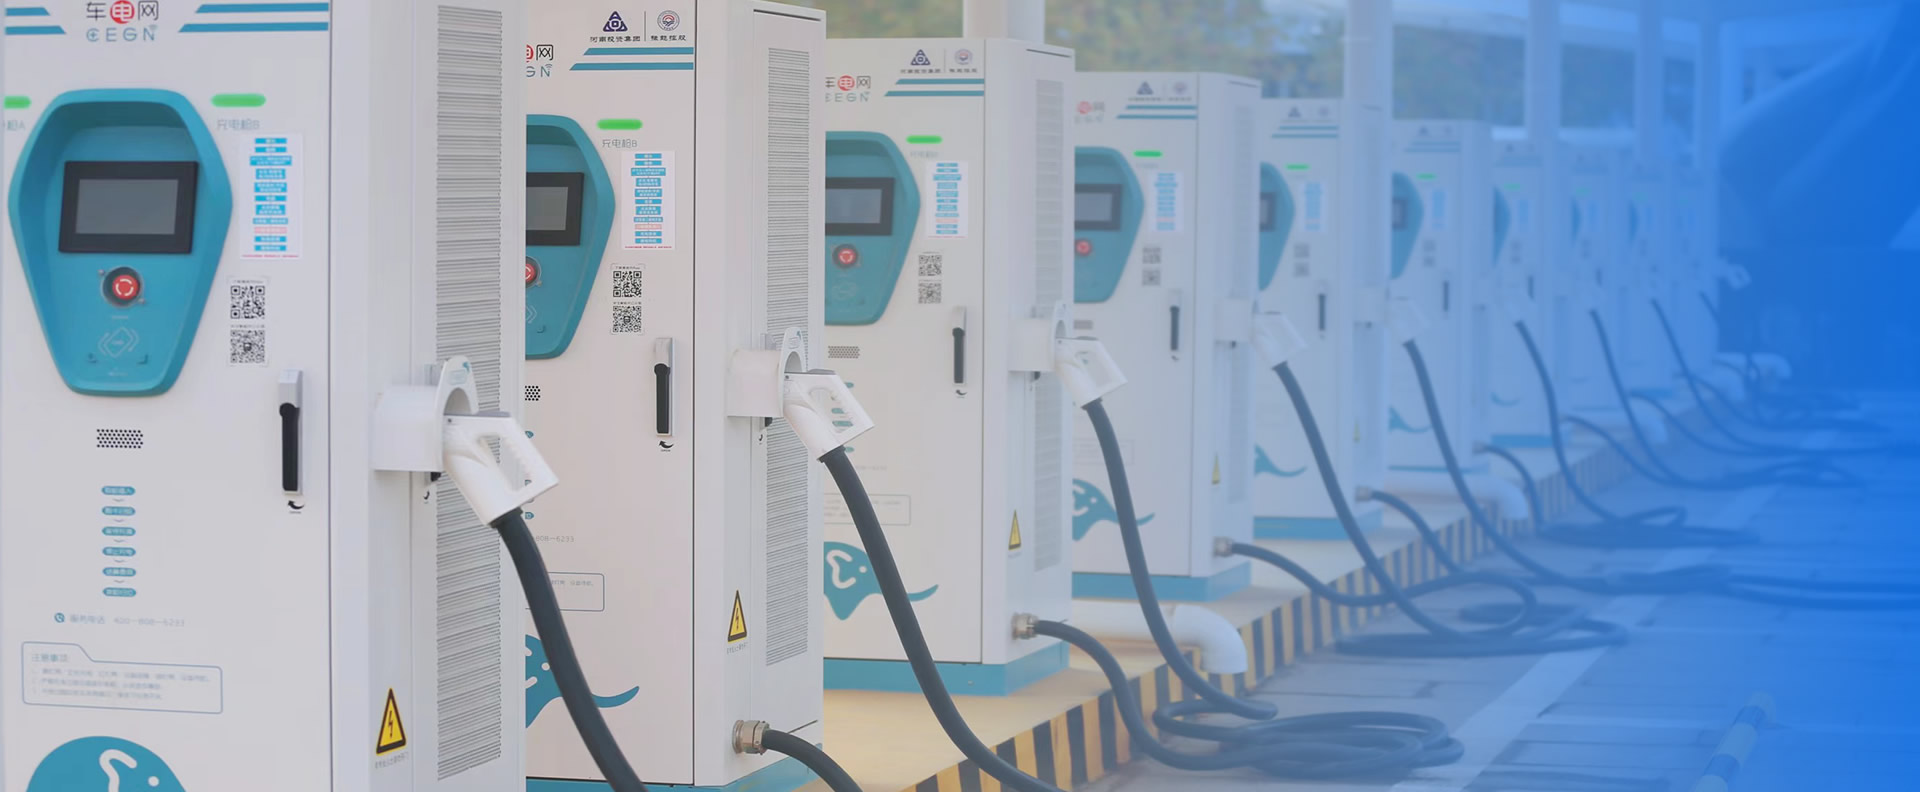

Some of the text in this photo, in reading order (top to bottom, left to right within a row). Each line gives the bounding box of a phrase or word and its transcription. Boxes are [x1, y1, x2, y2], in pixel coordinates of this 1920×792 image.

[86, 0, 159, 24] 车电网
[86, 26, 157, 42] CEGN
